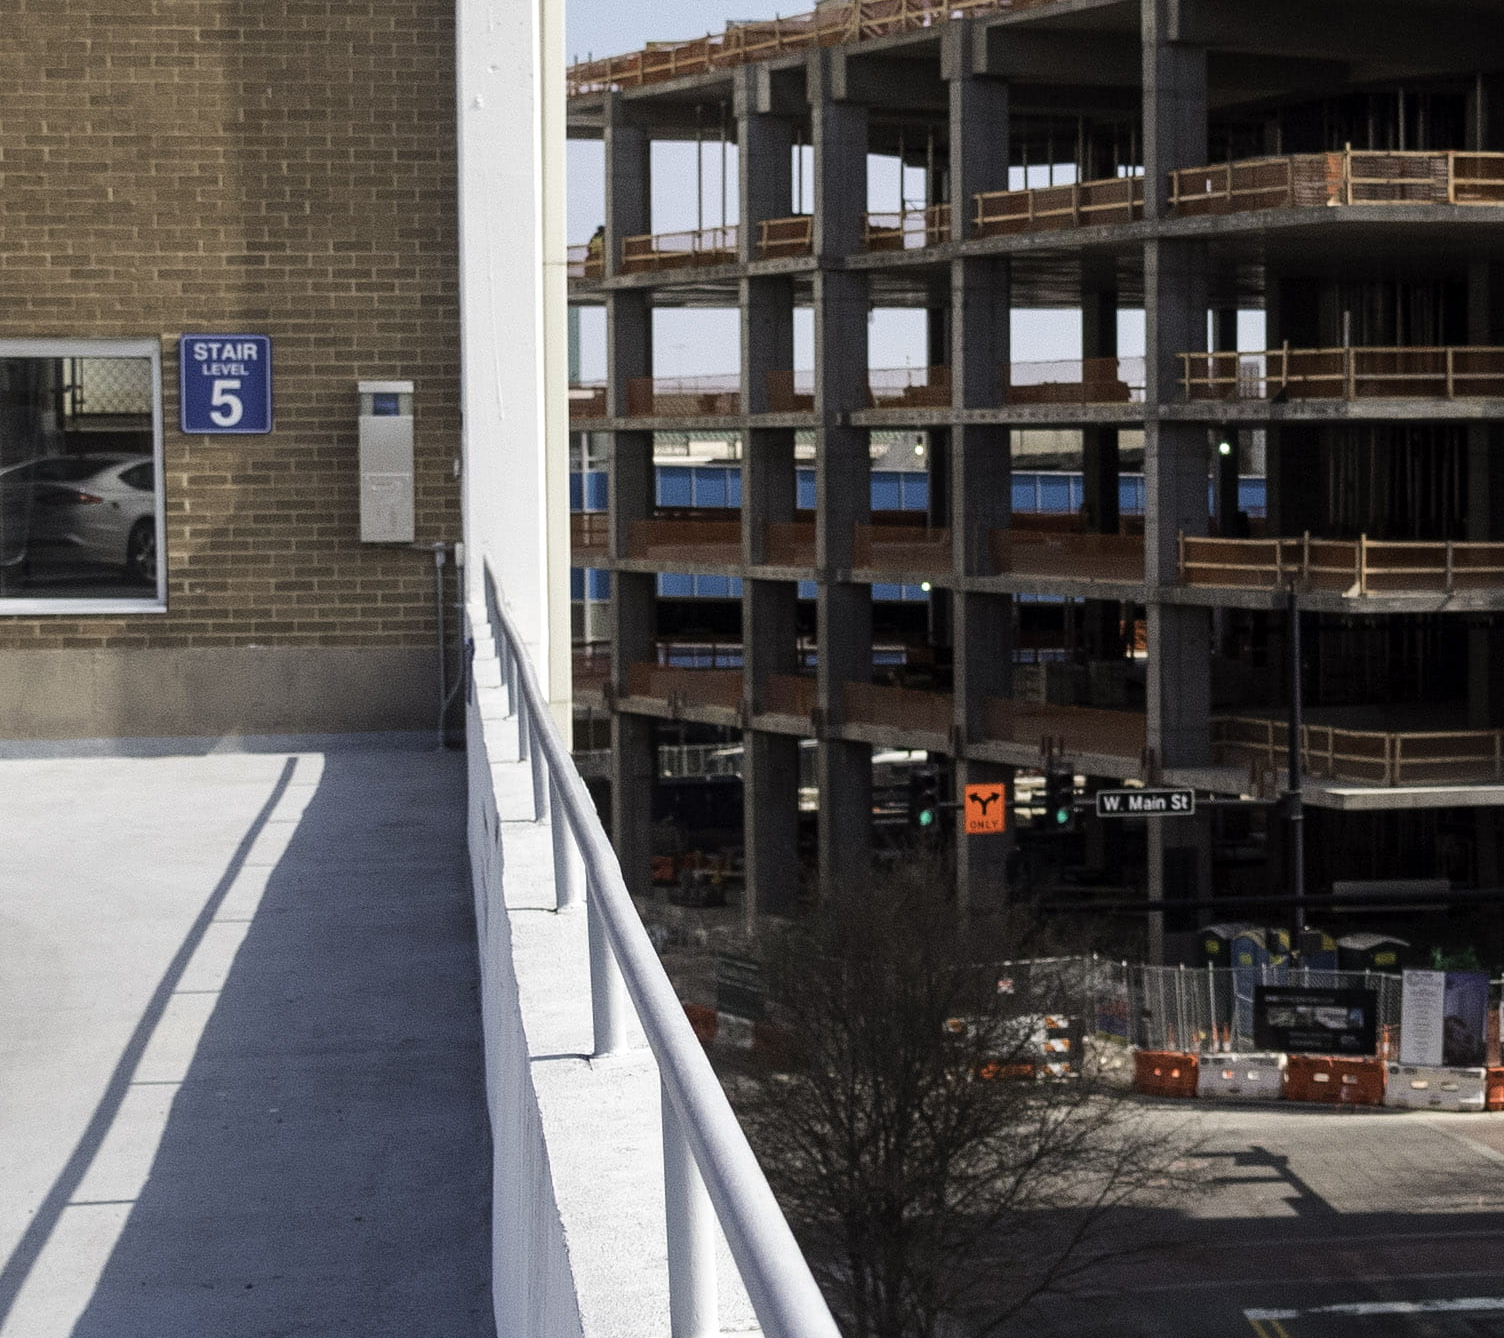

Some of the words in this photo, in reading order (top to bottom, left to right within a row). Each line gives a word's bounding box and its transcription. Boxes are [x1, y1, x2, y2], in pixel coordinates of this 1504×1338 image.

[193, 342, 258, 361] STAIR
[201, 363, 250, 376] LEVEL
[209, 378, 244, 428] 5
[1104, 795, 1124, 811] W.
[1128, 795, 1166, 811] Main
[1170, 793, 1189, 811] St
[969, 820, 999, 830] ONLY
